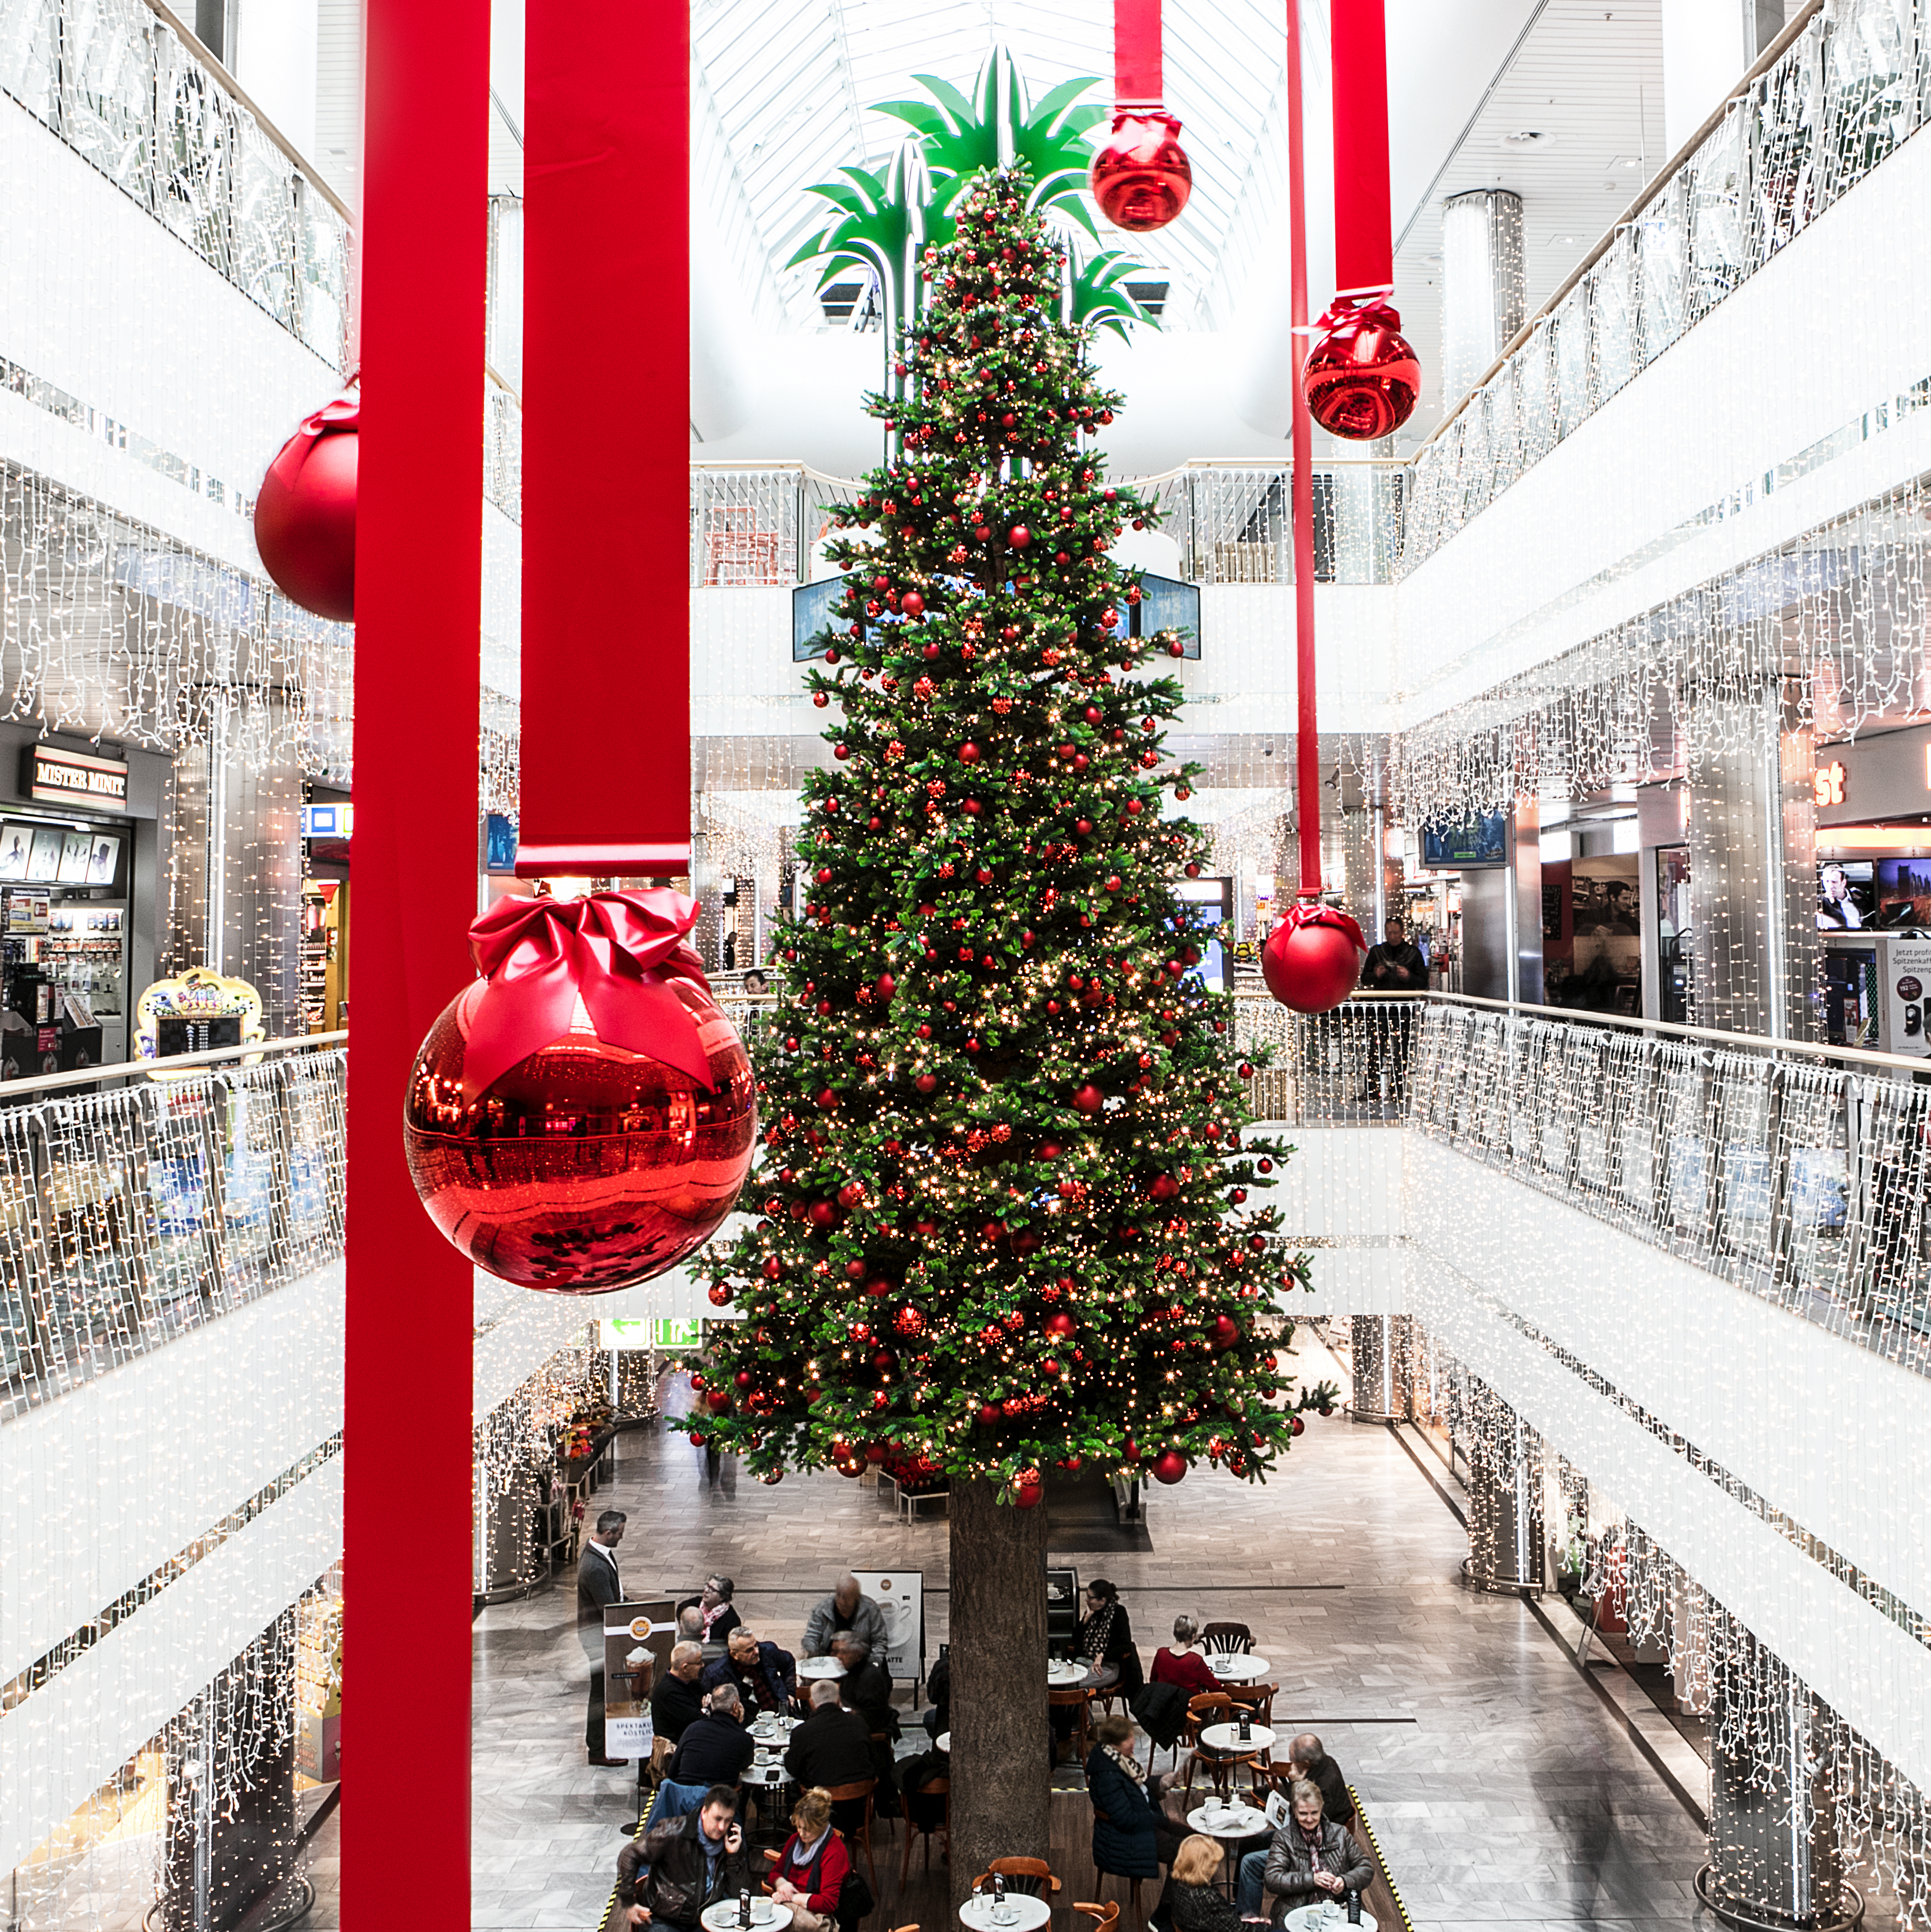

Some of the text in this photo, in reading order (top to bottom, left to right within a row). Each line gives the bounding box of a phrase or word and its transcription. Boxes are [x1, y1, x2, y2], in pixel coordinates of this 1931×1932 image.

[37, 763, 124, 796] MISTER MINIT
[1914, 948, 1931, 957] profi
[177, 991, 223, 1002] SUPER
[182, 1000, 222, 1010] BIKES
